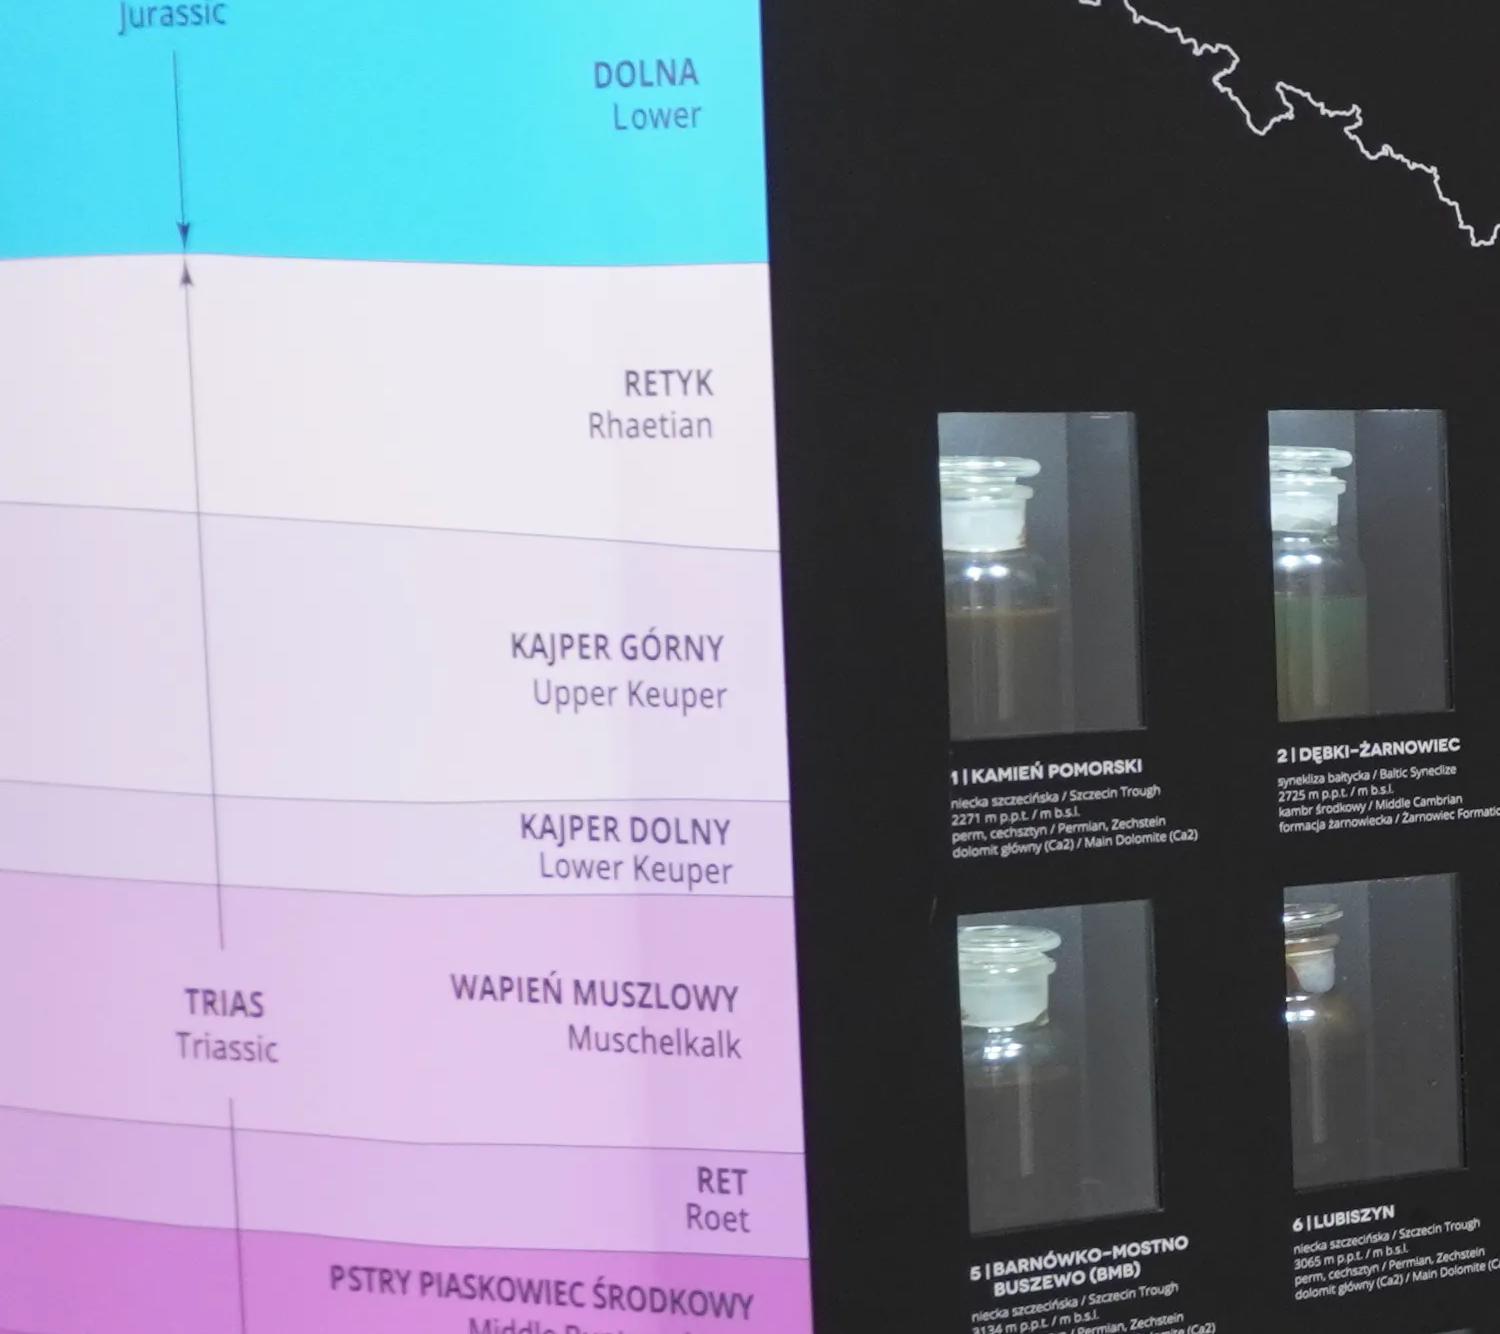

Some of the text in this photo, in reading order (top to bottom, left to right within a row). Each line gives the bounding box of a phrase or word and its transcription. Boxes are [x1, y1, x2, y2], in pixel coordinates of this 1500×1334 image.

[594, 57, 700, 90] DOLNA
[613, 103, 702, 131] Lower
[625, 369, 714, 397] RETYK
[589, 411, 712, 440] Rhaetian
[511, 627, 724, 666] KAJPER GÓRNY
[533, 679, 728, 716] Upper Keuper
[1277, 736, 1461, 764] 2 DĘBKI-ŻARNOWIEC
[951, 758, 1143, 785] 1 KAMIEŃ POMORSKI
[1379, 767, 1408, 780] Baltic
[950, 796, 989, 810] niecka
[991, 791, 1060, 808] szczecińska
[1069, 787, 1118, 802] Szczecin
[1119, 783, 1162, 800] Trough
[1278, 788, 1306, 803] 2725
[1308, 790, 1320, 800] m
[1357, 786, 1369, 797] m
[1278, 804, 1314, 818] kambr
[1315, 798, 1367, 815] środkowy
[1375, 797, 1412, 811] Middle
[1412, 794, 1463, 808] Cambrian
[520, 813, 731, 848] KAJPER DOLNY
[951, 812, 981, 827] 2271
[984, 812, 998, 824] m
[1039, 809, 1052, 820] m
[951, 830, 988, 845] perm,
[989, 825, 1048, 840] cechsztyn
[1057, 821, 1109, 835] Permian,
[1111, 815, 1167, 831] Zechstein
[1278, 819, 1327, 834] formacja
[1401, 810, 1456, 824] Żarnowiec
[952, 842, 999, 859] dolomit
[1000, 837, 1043, 857] główny
[1043, 837, 1075, 853] (Ca2)
[1084, 835, 1113, 849] Main
[1115, 831, 1168, 847] Dolomite
[1168, 828, 1199, 844] (Ca2)
[540, 851, 733, 890] Lower Keuper
[184, 988, 264, 1019] TRIAS
[450, 970, 739, 1013] WAPIEŃ MUSZLOWY
[175, 1030, 279, 1064] Triassic
[568, 1023, 742, 1059] Muschelkalk
[697, 1166, 748, 1196] RET
[686, 1202, 751, 1234] Roet
[1292, 1204, 1395, 1232] 6 LUBISZYN
[970, 1235, 1189, 1281] 5 BARNÓWKO-MOSTNO
[330, 1264, 754, 1320] PSTRY PIASKOWIEC ŚRODKOWY
[993, 1260, 1141, 1297] BUSZEWO (BMB)
